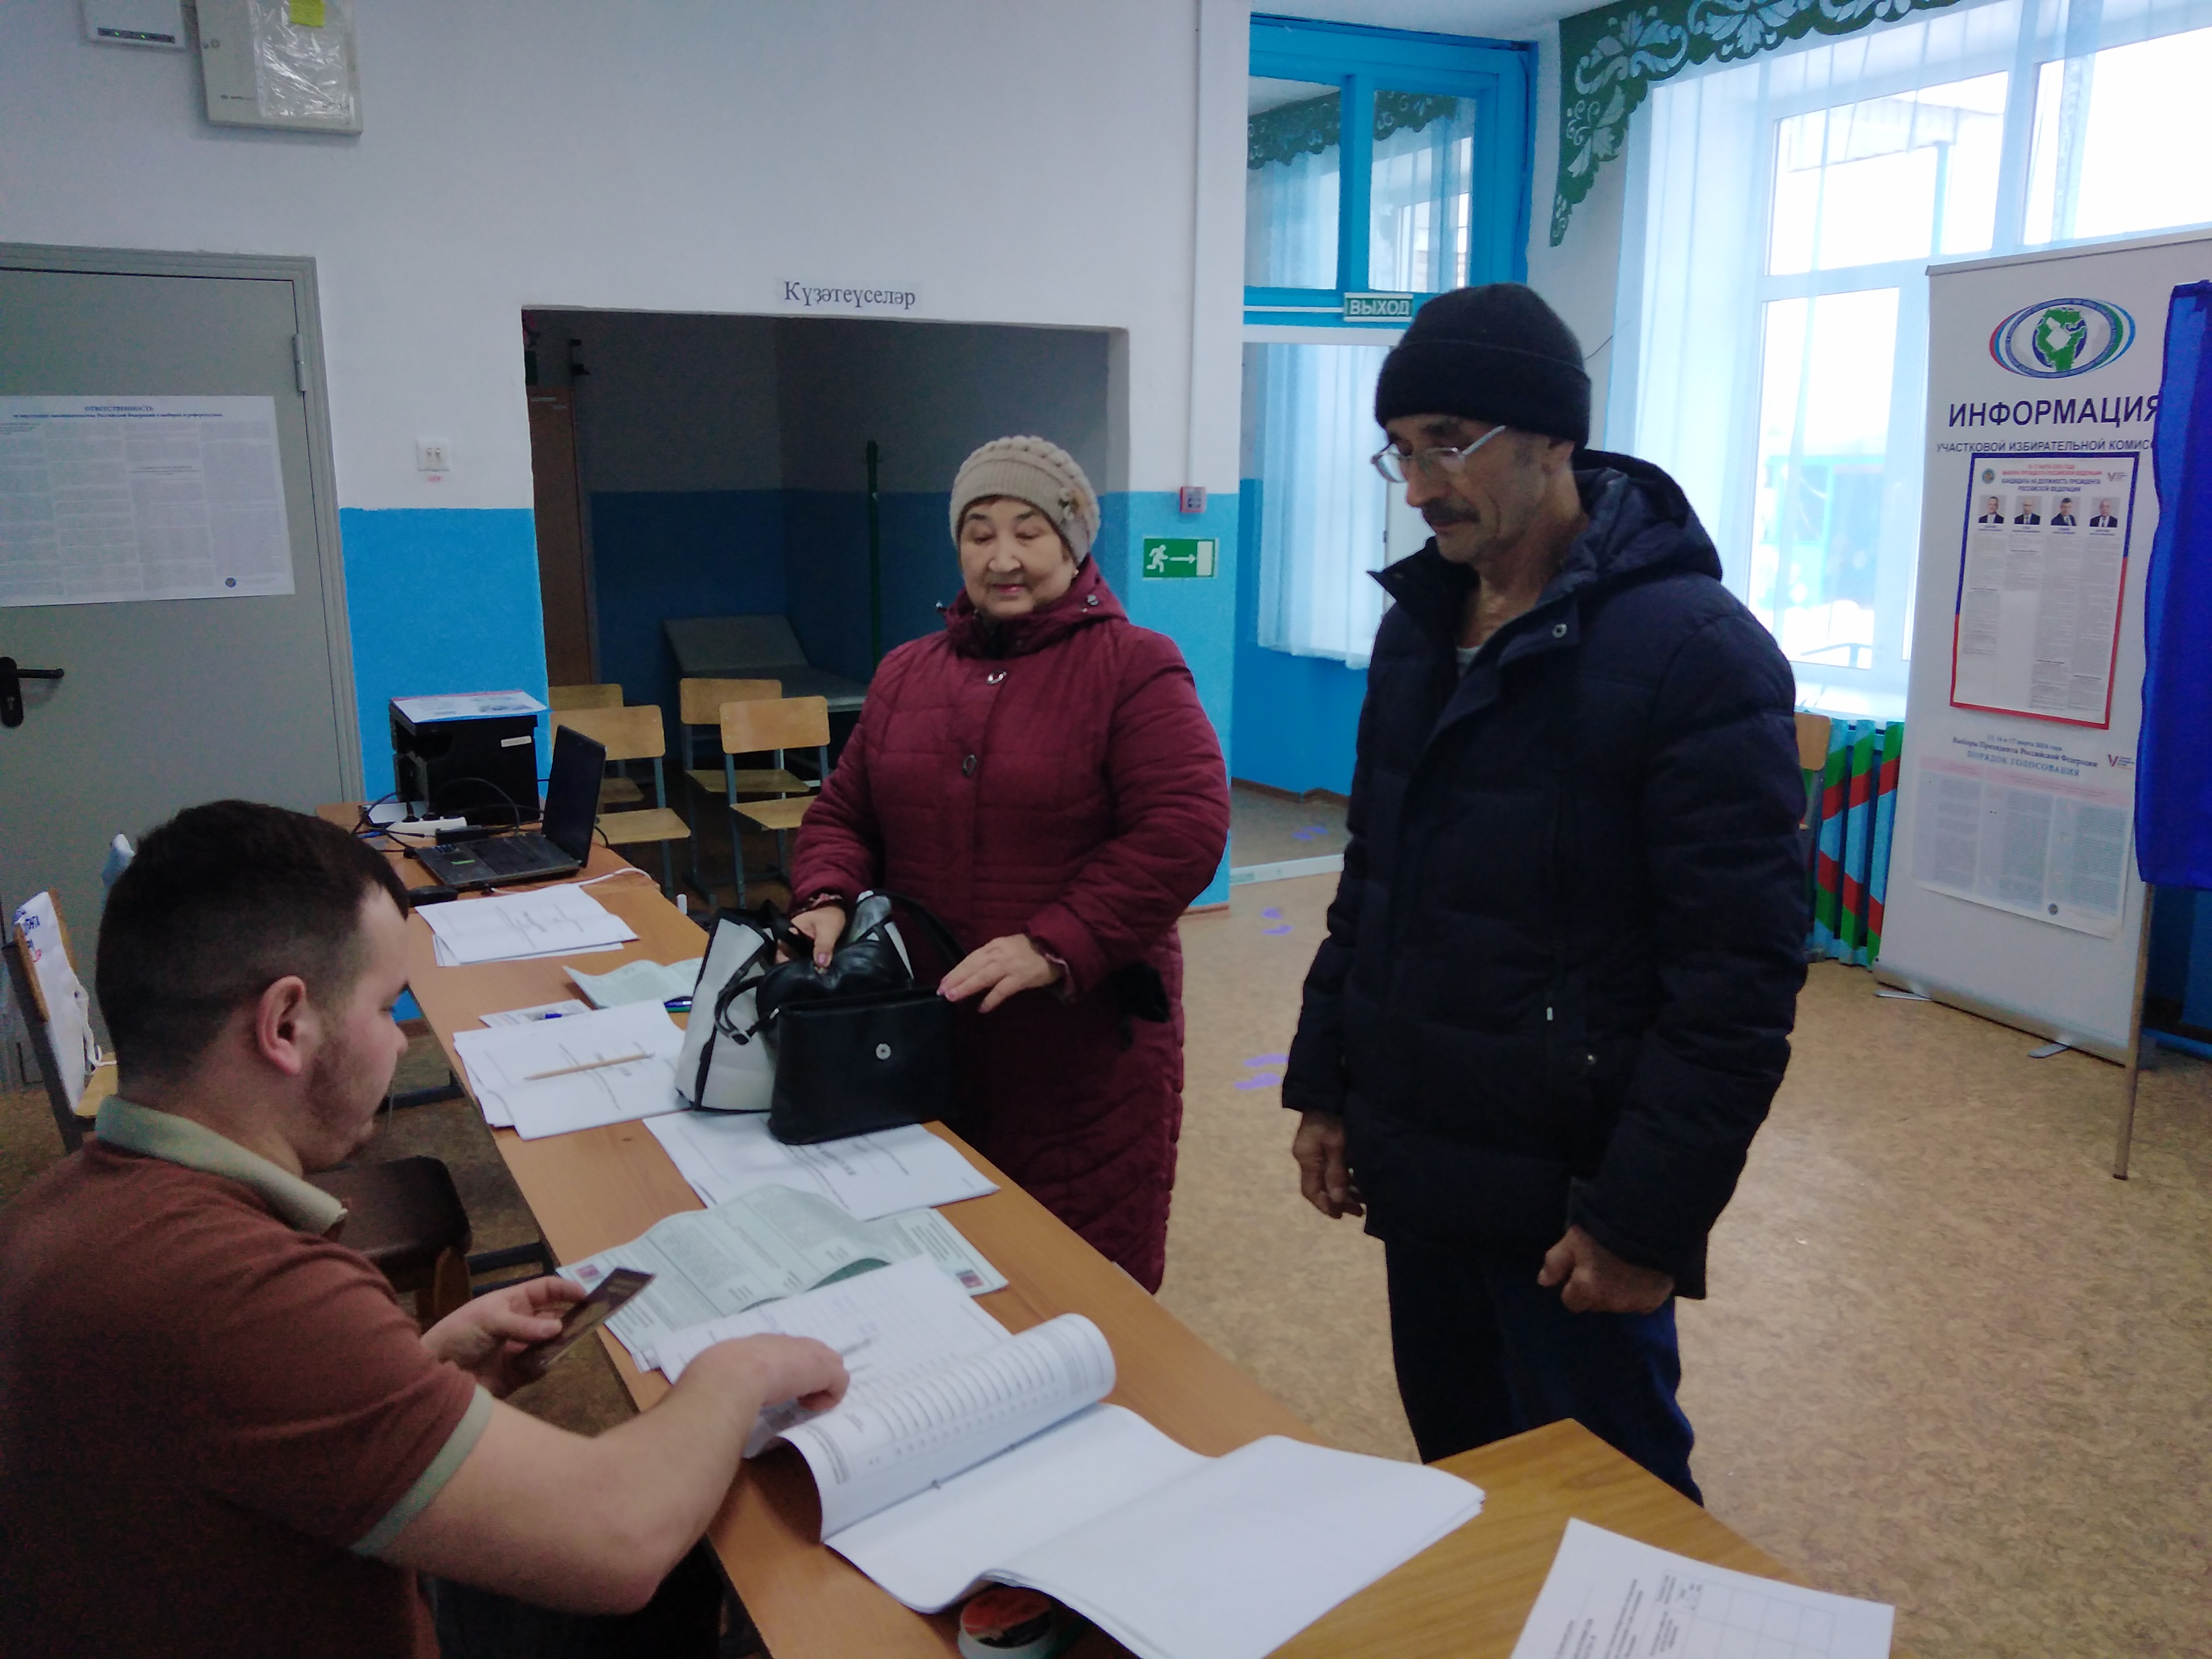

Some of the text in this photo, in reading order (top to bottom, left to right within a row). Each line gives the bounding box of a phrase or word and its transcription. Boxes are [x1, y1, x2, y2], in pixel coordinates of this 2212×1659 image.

[784, 281, 915, 309] Күҙәтеүселәр
[1350, 299, 1410, 315] ВЫХОД
[1949, 395, 2158, 428] ИНФОРМАЦИЯ
[1937, 439, 2153, 452] УЧАСТКОВОЙ ИЗБИРАТЕЛЬНОЙ КОМИС
